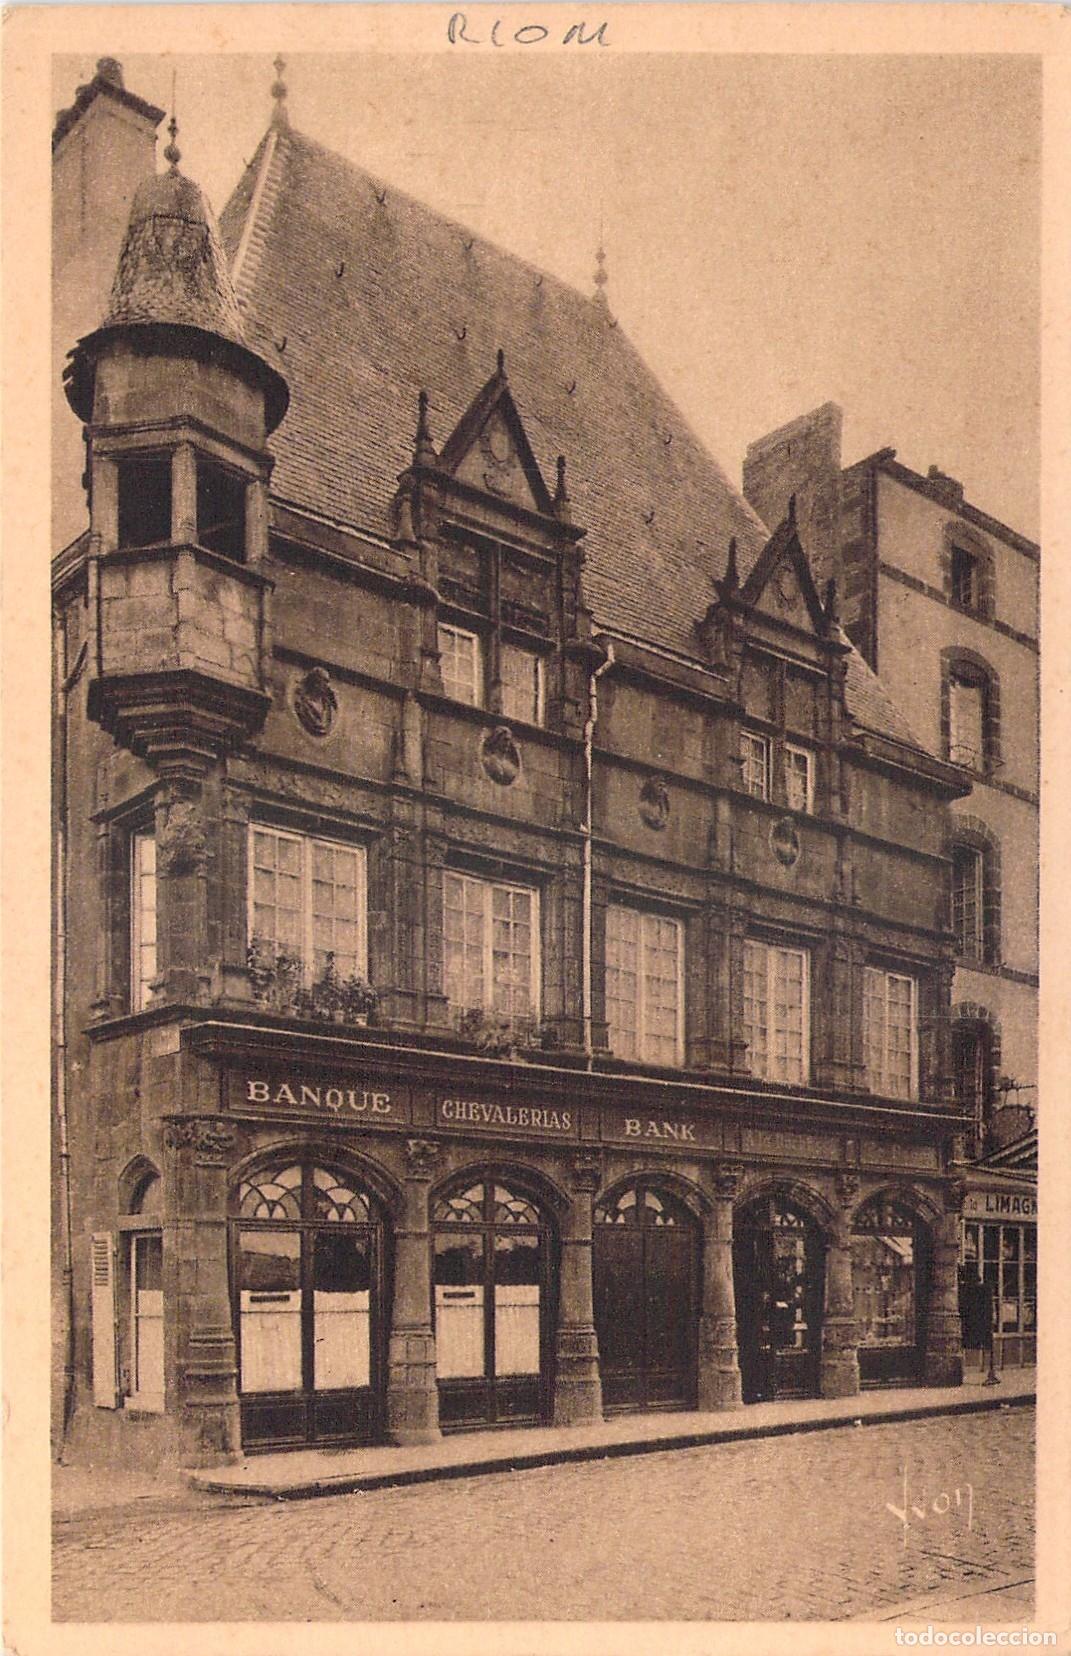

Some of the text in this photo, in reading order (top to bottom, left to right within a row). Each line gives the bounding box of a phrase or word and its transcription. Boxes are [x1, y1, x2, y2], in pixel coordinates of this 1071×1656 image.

[246, 1080, 696, 1141] BANQUE CHEVALERIAS BANK
